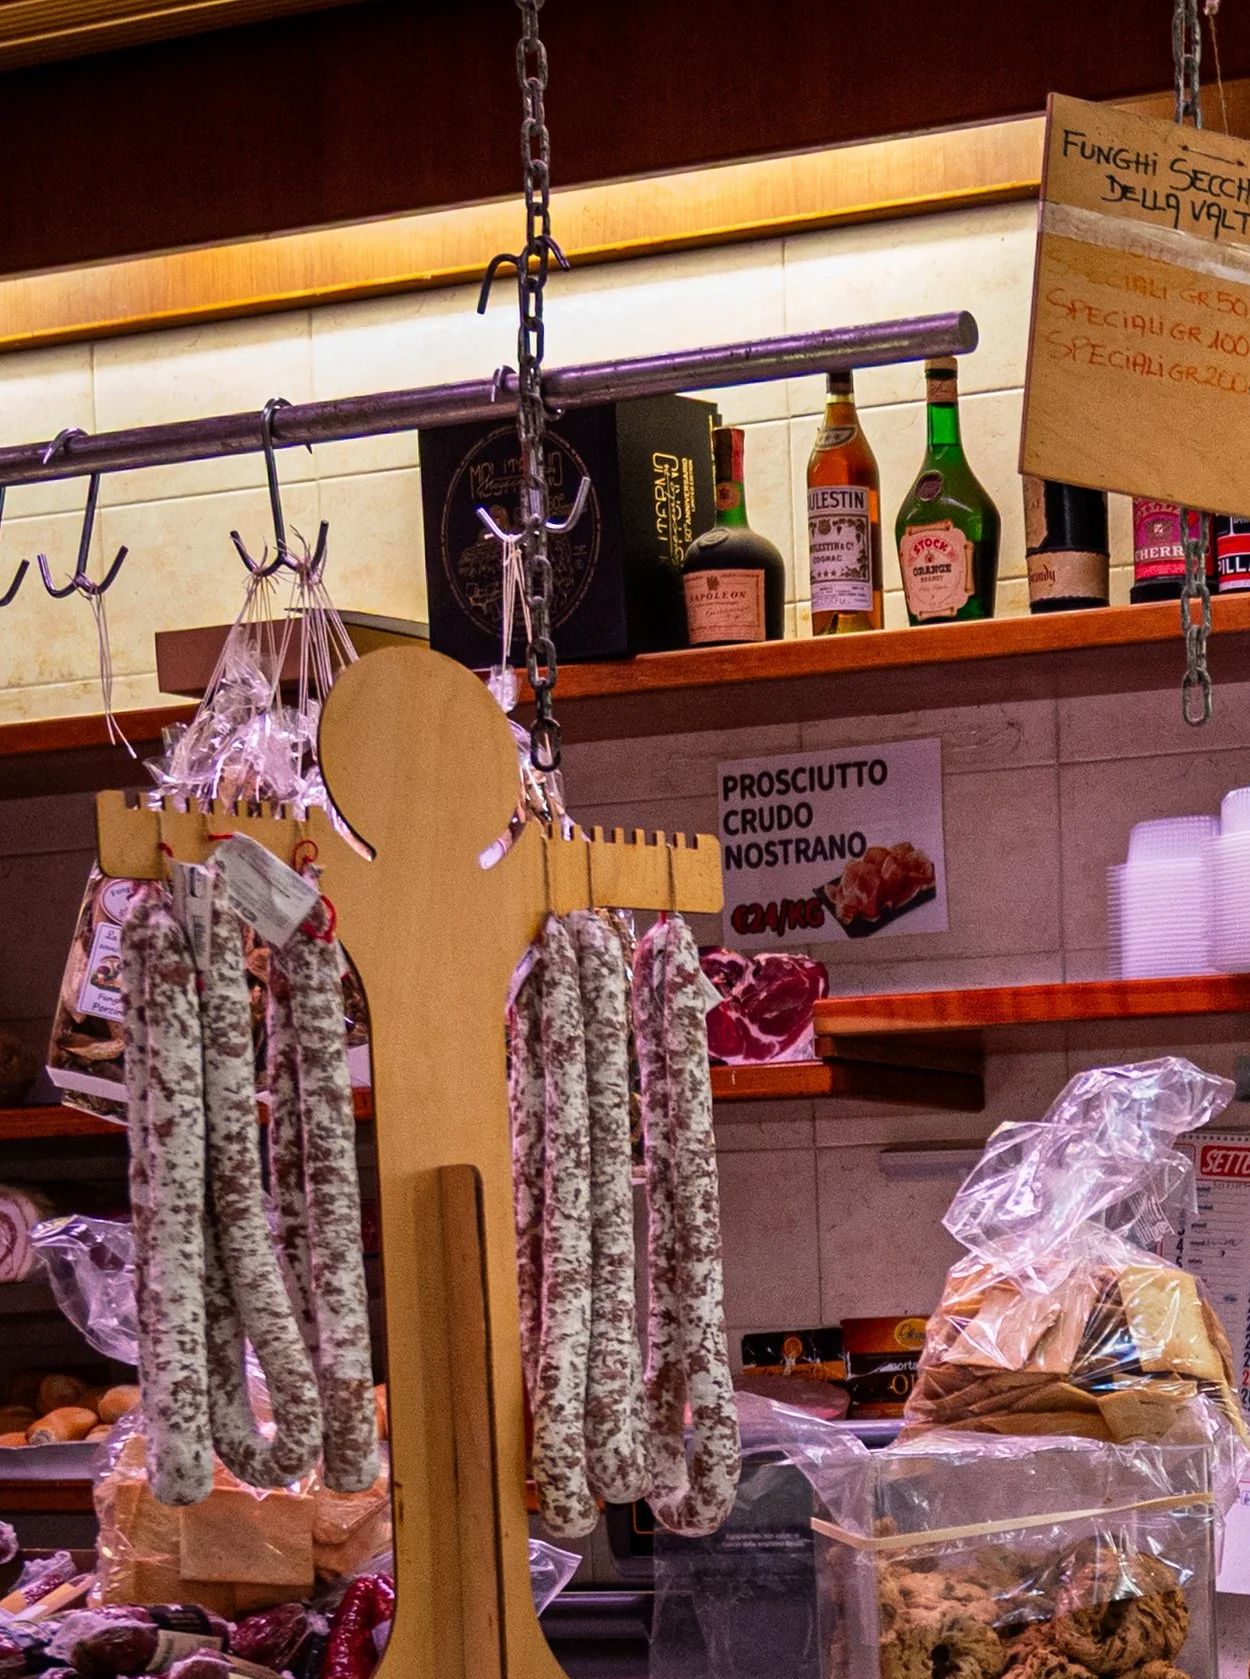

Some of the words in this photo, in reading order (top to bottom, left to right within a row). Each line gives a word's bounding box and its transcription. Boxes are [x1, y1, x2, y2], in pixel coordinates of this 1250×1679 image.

[808, 490, 865, 511] ULESTIN
[913, 537, 949, 555] STOCK
[1134, 545, 1186, 562] CHERR
[912, 563, 952, 577] ORANGE
[722, 758, 888, 801] PROSCIUTTO
[722, 802, 814, 836] CRUDO
[724, 831, 867, 870] NOSTRANO
